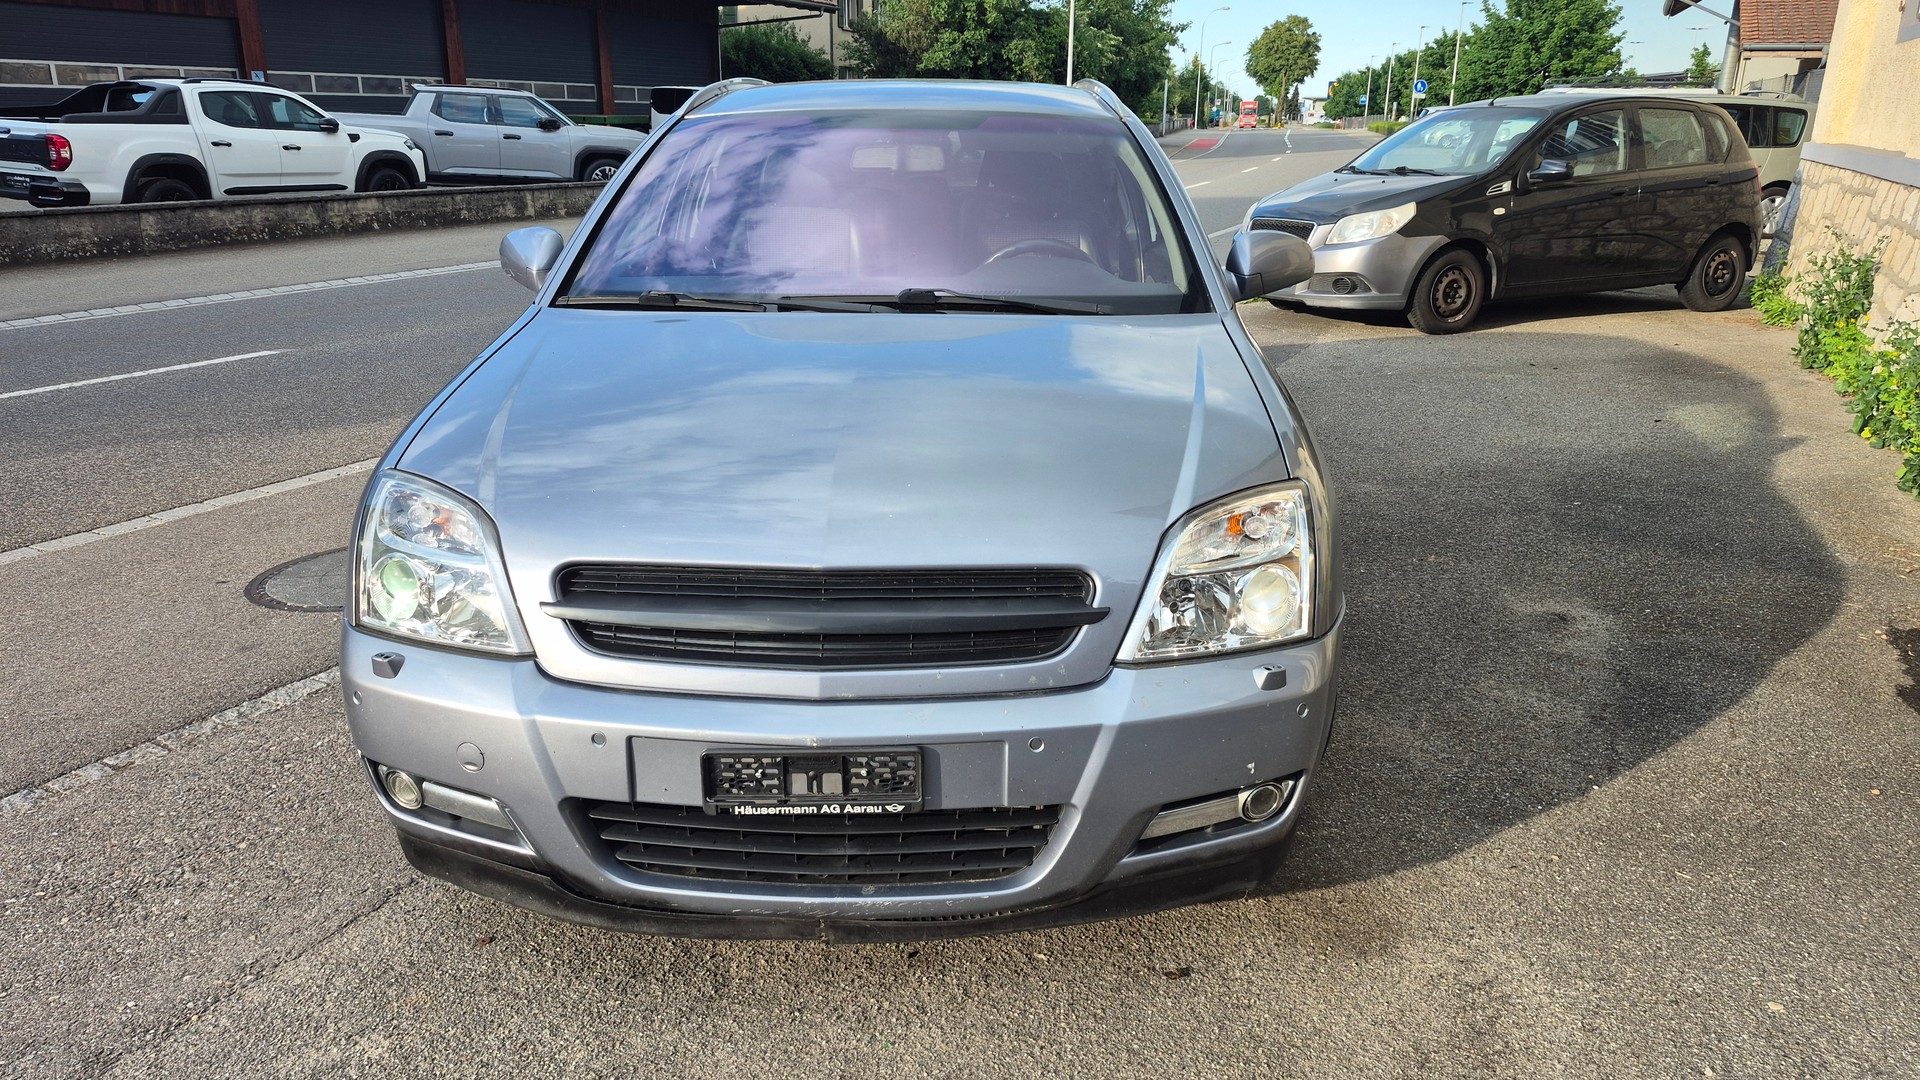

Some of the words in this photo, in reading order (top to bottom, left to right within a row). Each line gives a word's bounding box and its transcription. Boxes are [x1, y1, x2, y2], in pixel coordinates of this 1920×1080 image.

[734, 805, 818, 815] Häusermann
[820, 804, 841, 814] AG
[843, 804, 882, 813] Aarau
